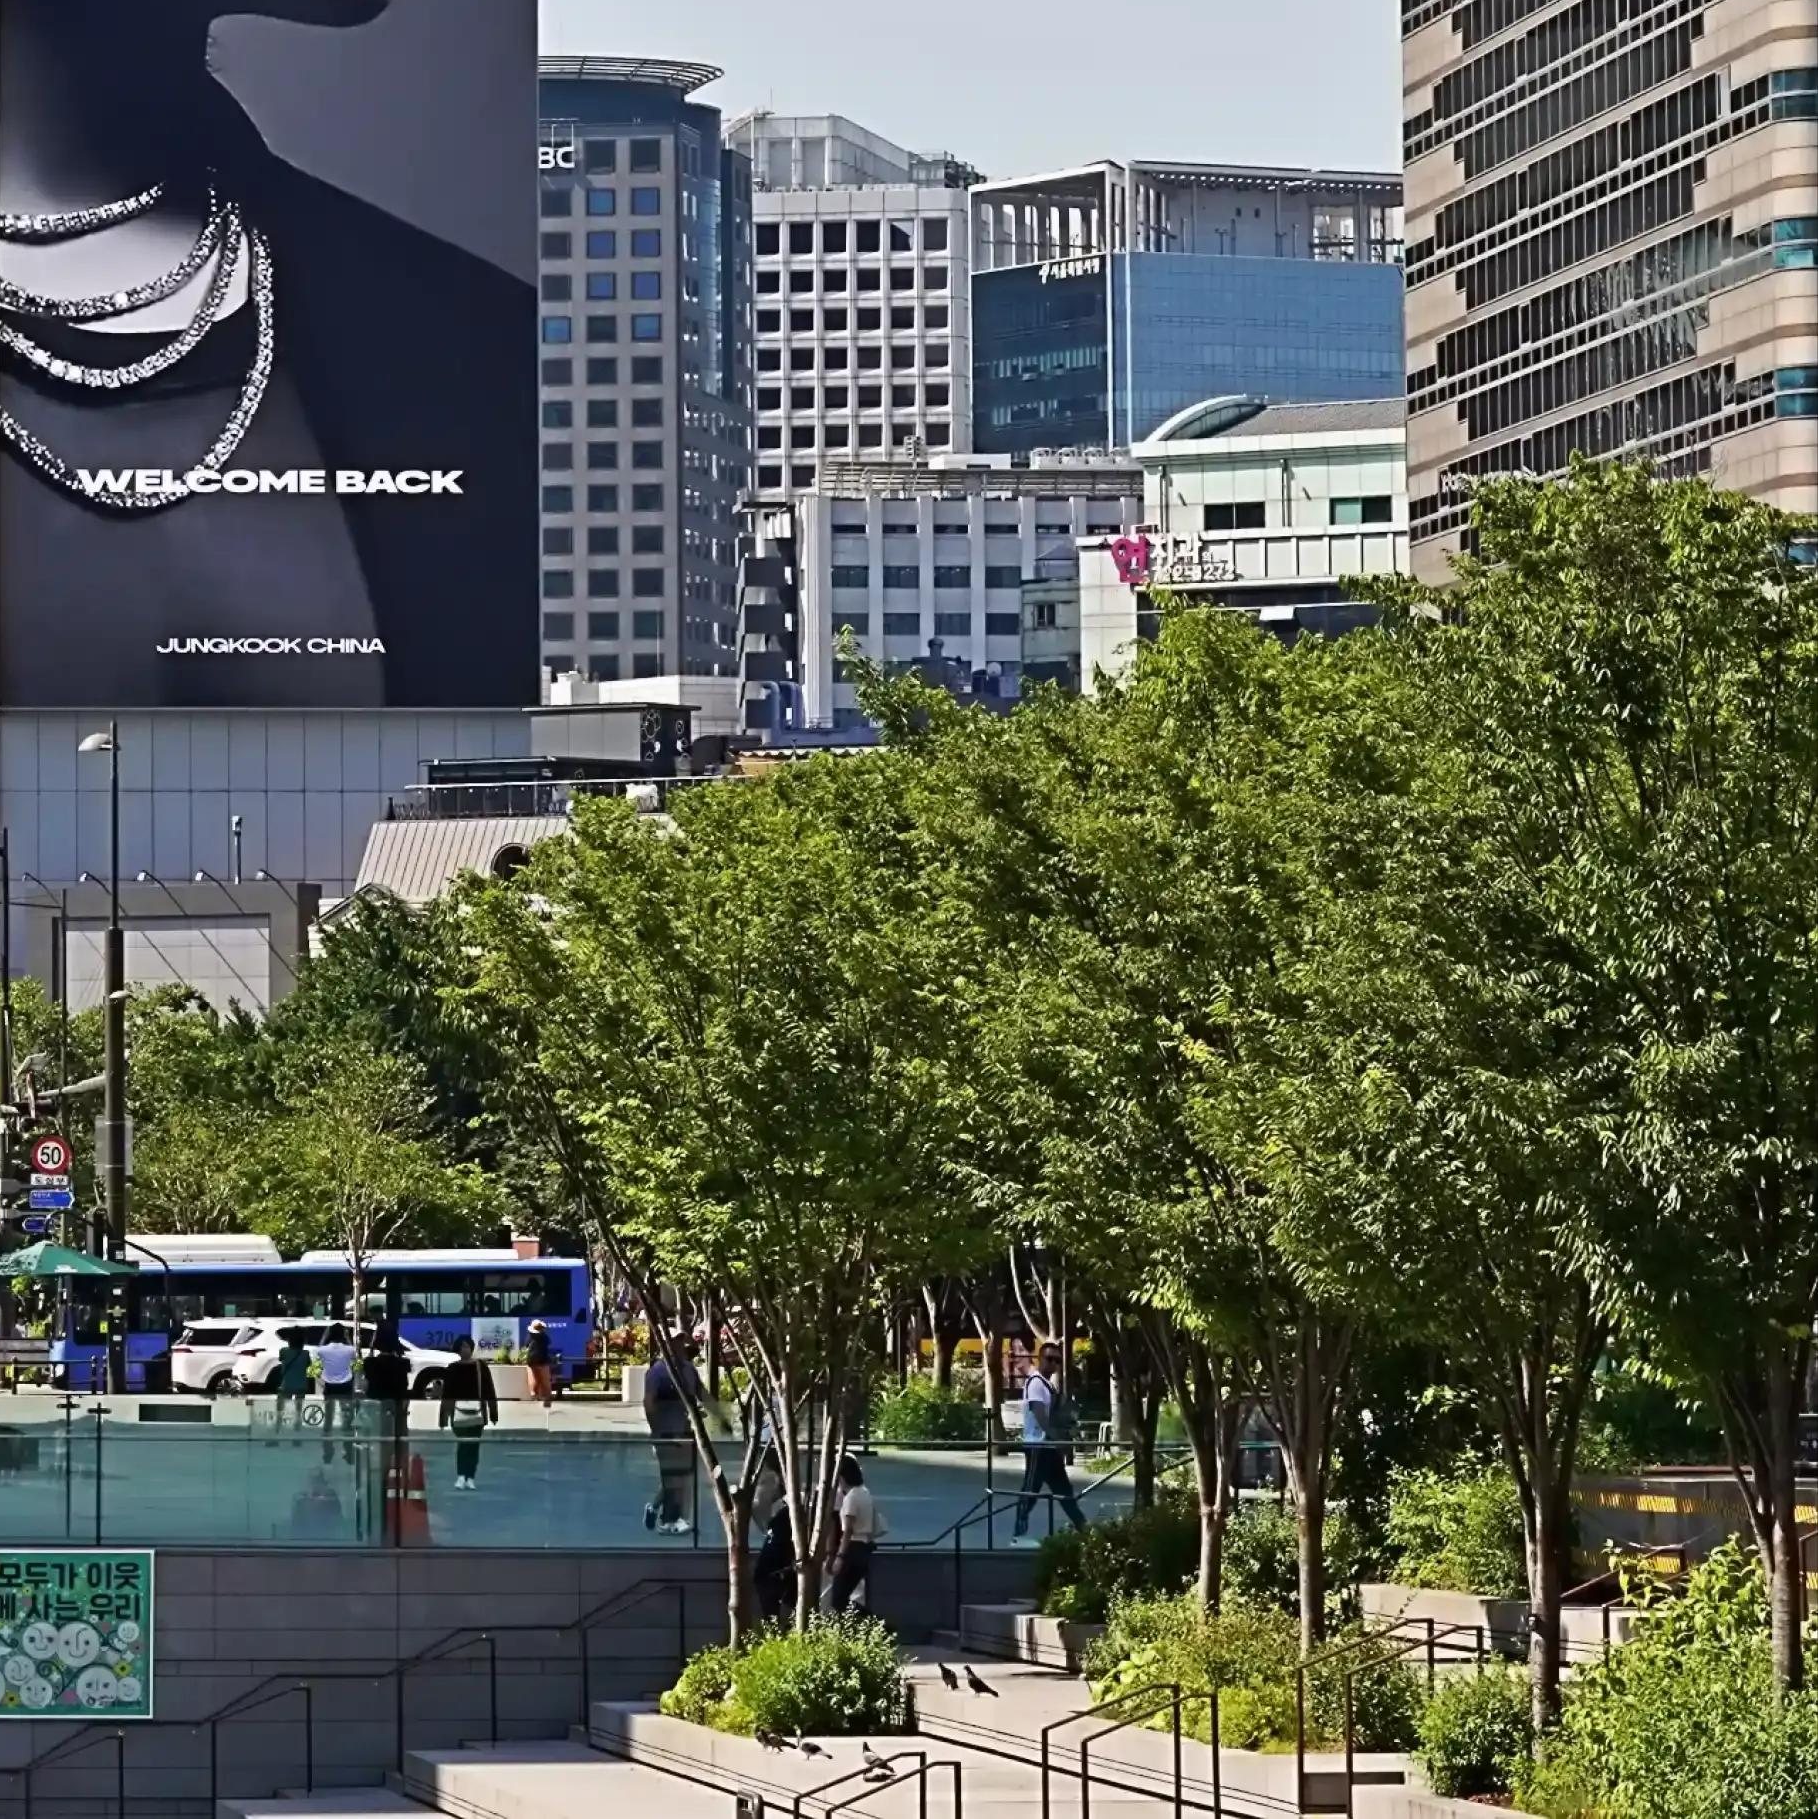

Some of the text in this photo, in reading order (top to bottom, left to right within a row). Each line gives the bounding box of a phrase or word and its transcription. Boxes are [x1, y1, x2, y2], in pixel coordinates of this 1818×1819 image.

[77, 468, 464, 494] WELCOME BACK
[156, 637, 386, 654] JUNGKOOK CHINA
[40, 1146, 62, 1165] 50
[87, 1562, 141, 1591] 이웃
[27, 1594, 80, 1620] 사는
[89, 1593, 140, 1621] 우리
